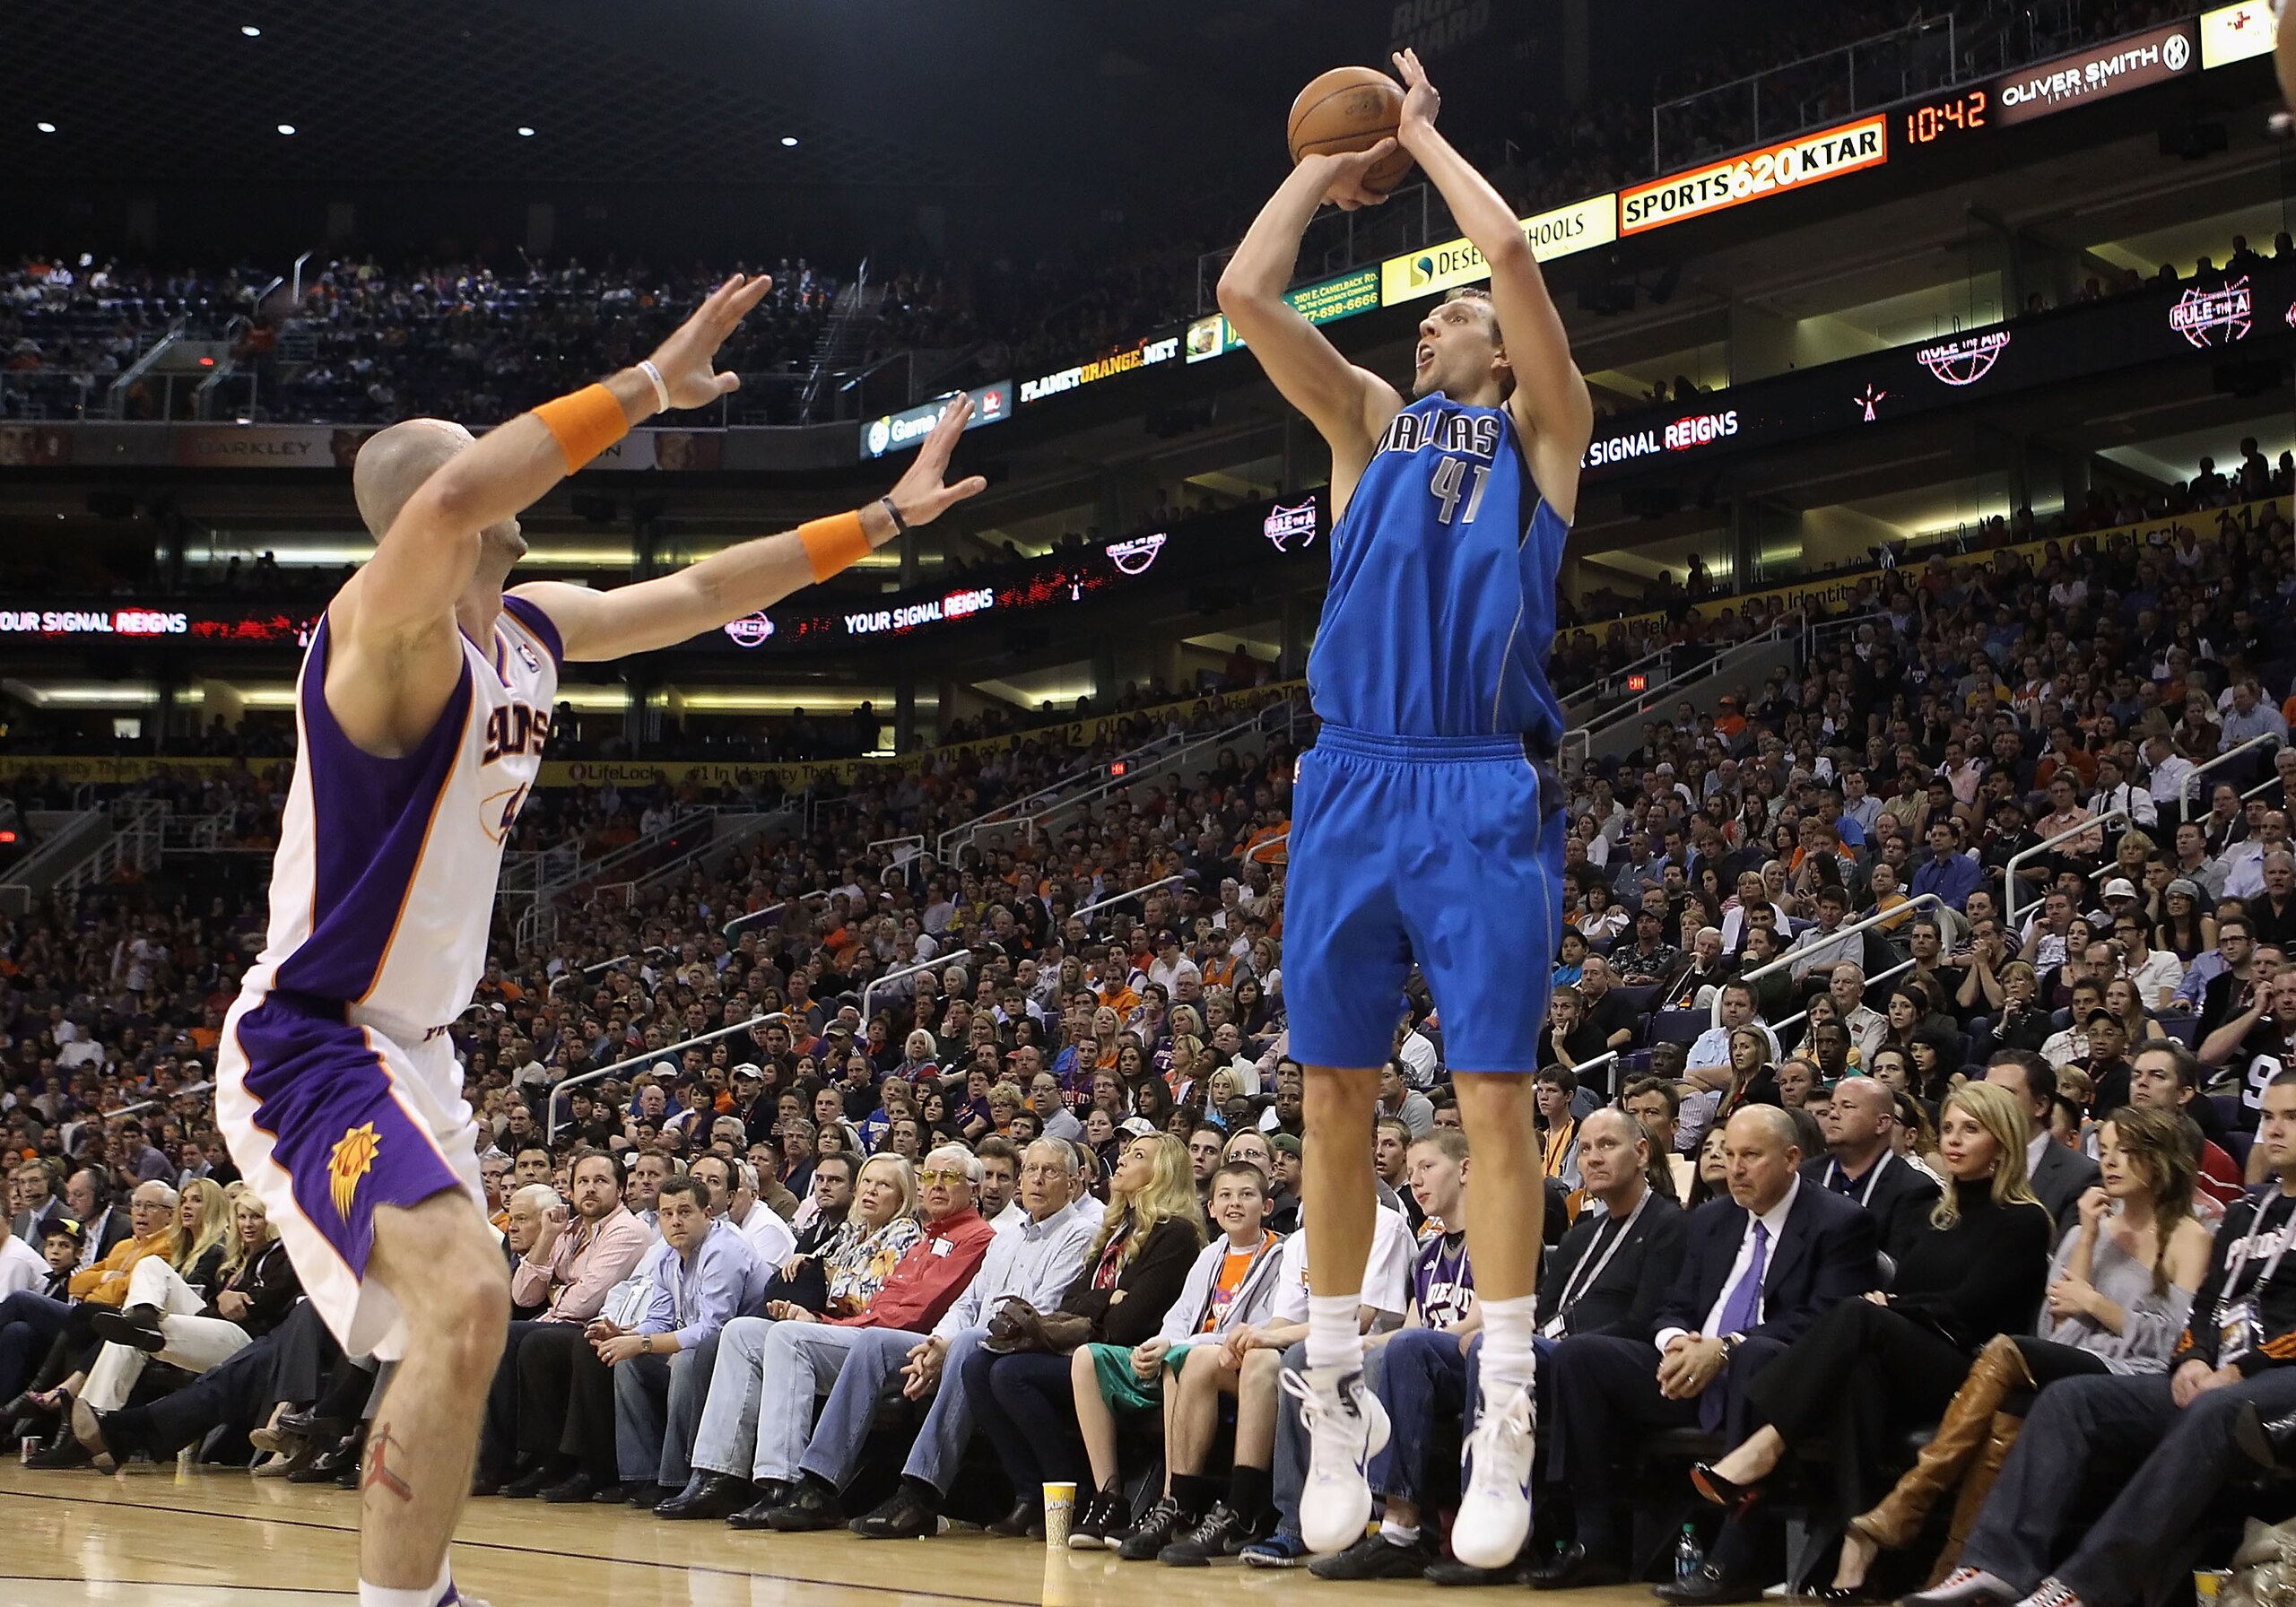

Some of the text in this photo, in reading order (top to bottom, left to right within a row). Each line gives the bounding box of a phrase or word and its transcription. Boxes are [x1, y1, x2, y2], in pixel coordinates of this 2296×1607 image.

[1391, 0, 1467, 39] RIGH
[2001, 44, 2159, 107] OLIVER SMITH
[1908, 91, 1987, 144] 10:42
[1626, 130, 1877, 222] SPORTS 620 KTAR
[1526, 213, 1585, 248] HOOLS
[1294, 292, 1310, 305] 3101
[1311, 290, 1319, 300] E.
[1320, 276, 1362, 297] CAMELBACK
[1302, 292, 1378, 322] 77-698-6666
[2173, 300, 2213, 326] RULE
[1020, 337, 1178, 402] PLANETORANGE.NET
[891, 414, 937, 442] Game
[1373, 408, 1500, 459] DALLAS
[1589, 430, 1661, 466] SIGNAL
[1665, 410, 1738, 449] REIGNS
[1431, 456, 1492, 525] 41
[1266, 516, 1292, 535] RULE
[0, 611, 187, 633] OUR SIGNAL REIGNS
[844, 587, 994, 635] YOUR SIGNAL REIGNS
[1628, 674, 1647, 691] EXIT
[481, 703, 549, 767] SUNS
[714, 766, 729, 780] In
